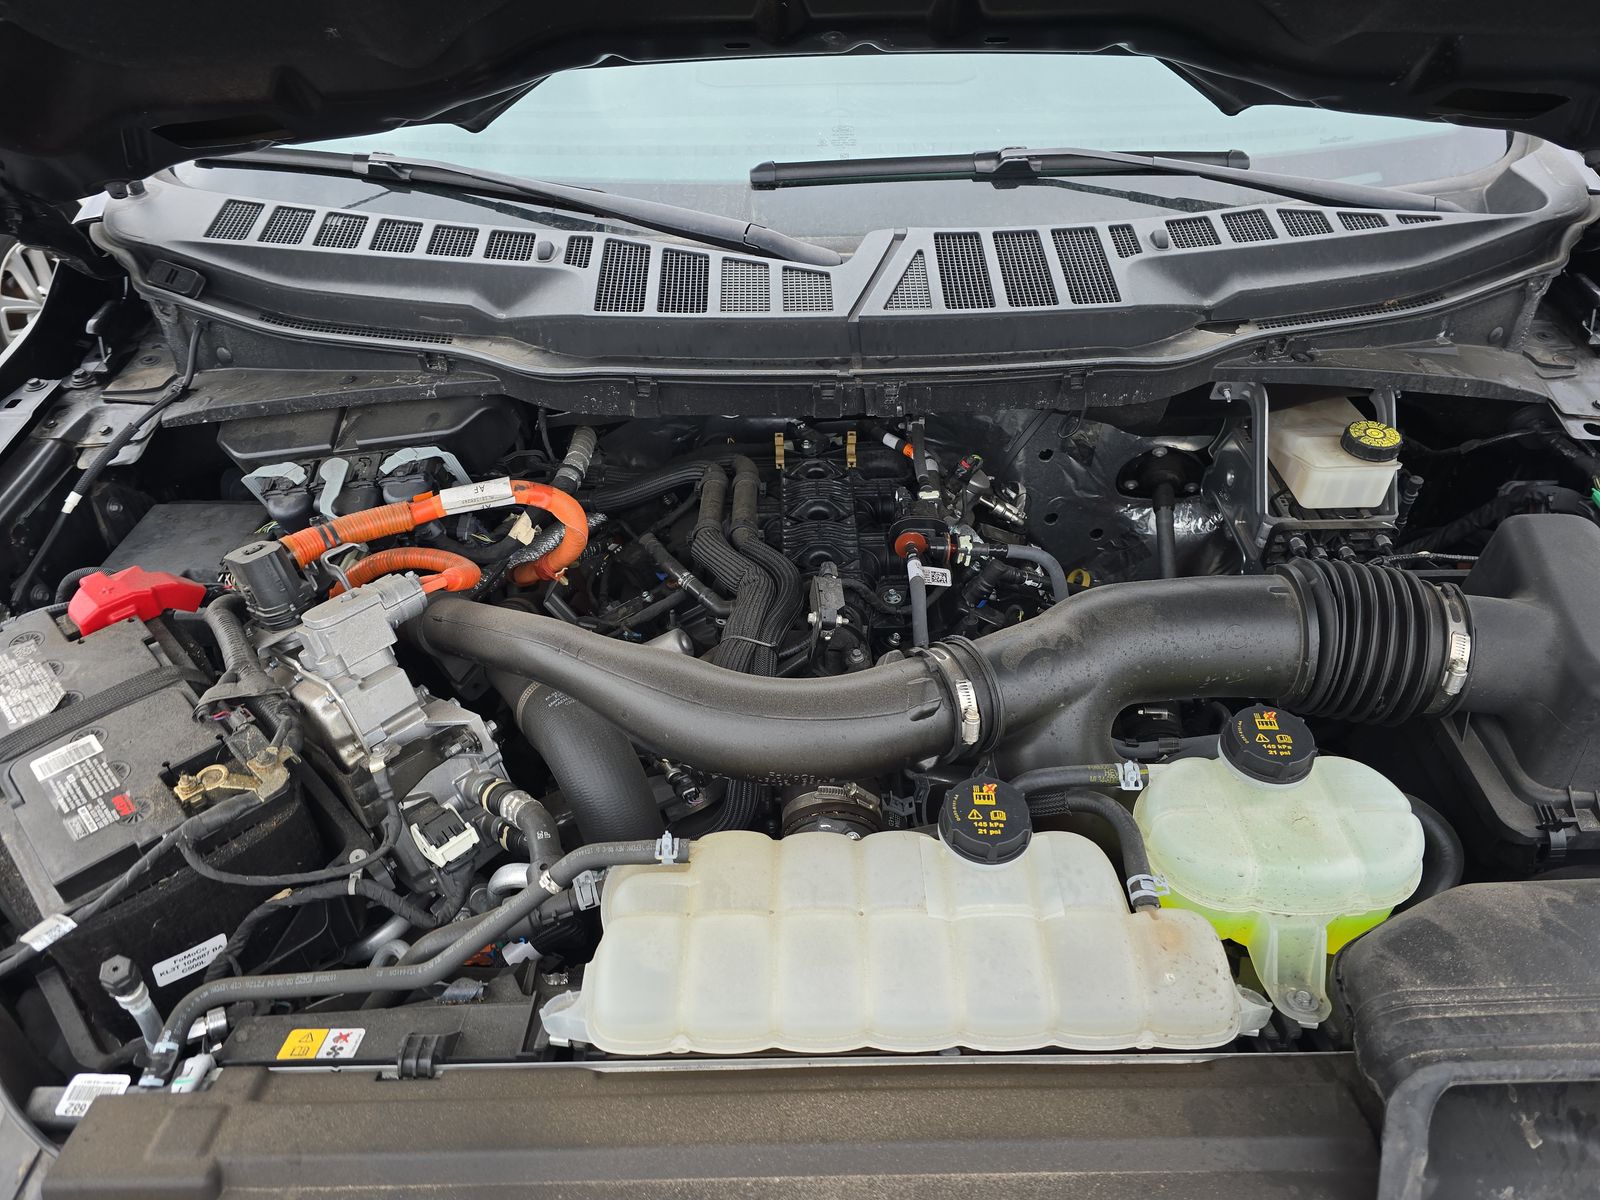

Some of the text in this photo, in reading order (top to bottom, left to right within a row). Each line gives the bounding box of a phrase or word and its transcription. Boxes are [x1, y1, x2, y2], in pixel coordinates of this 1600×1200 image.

[473, 484, 485, 494] AF
[173, 946, 208, 965] FoMoCo
[159, 964, 180, 977] KL3T
